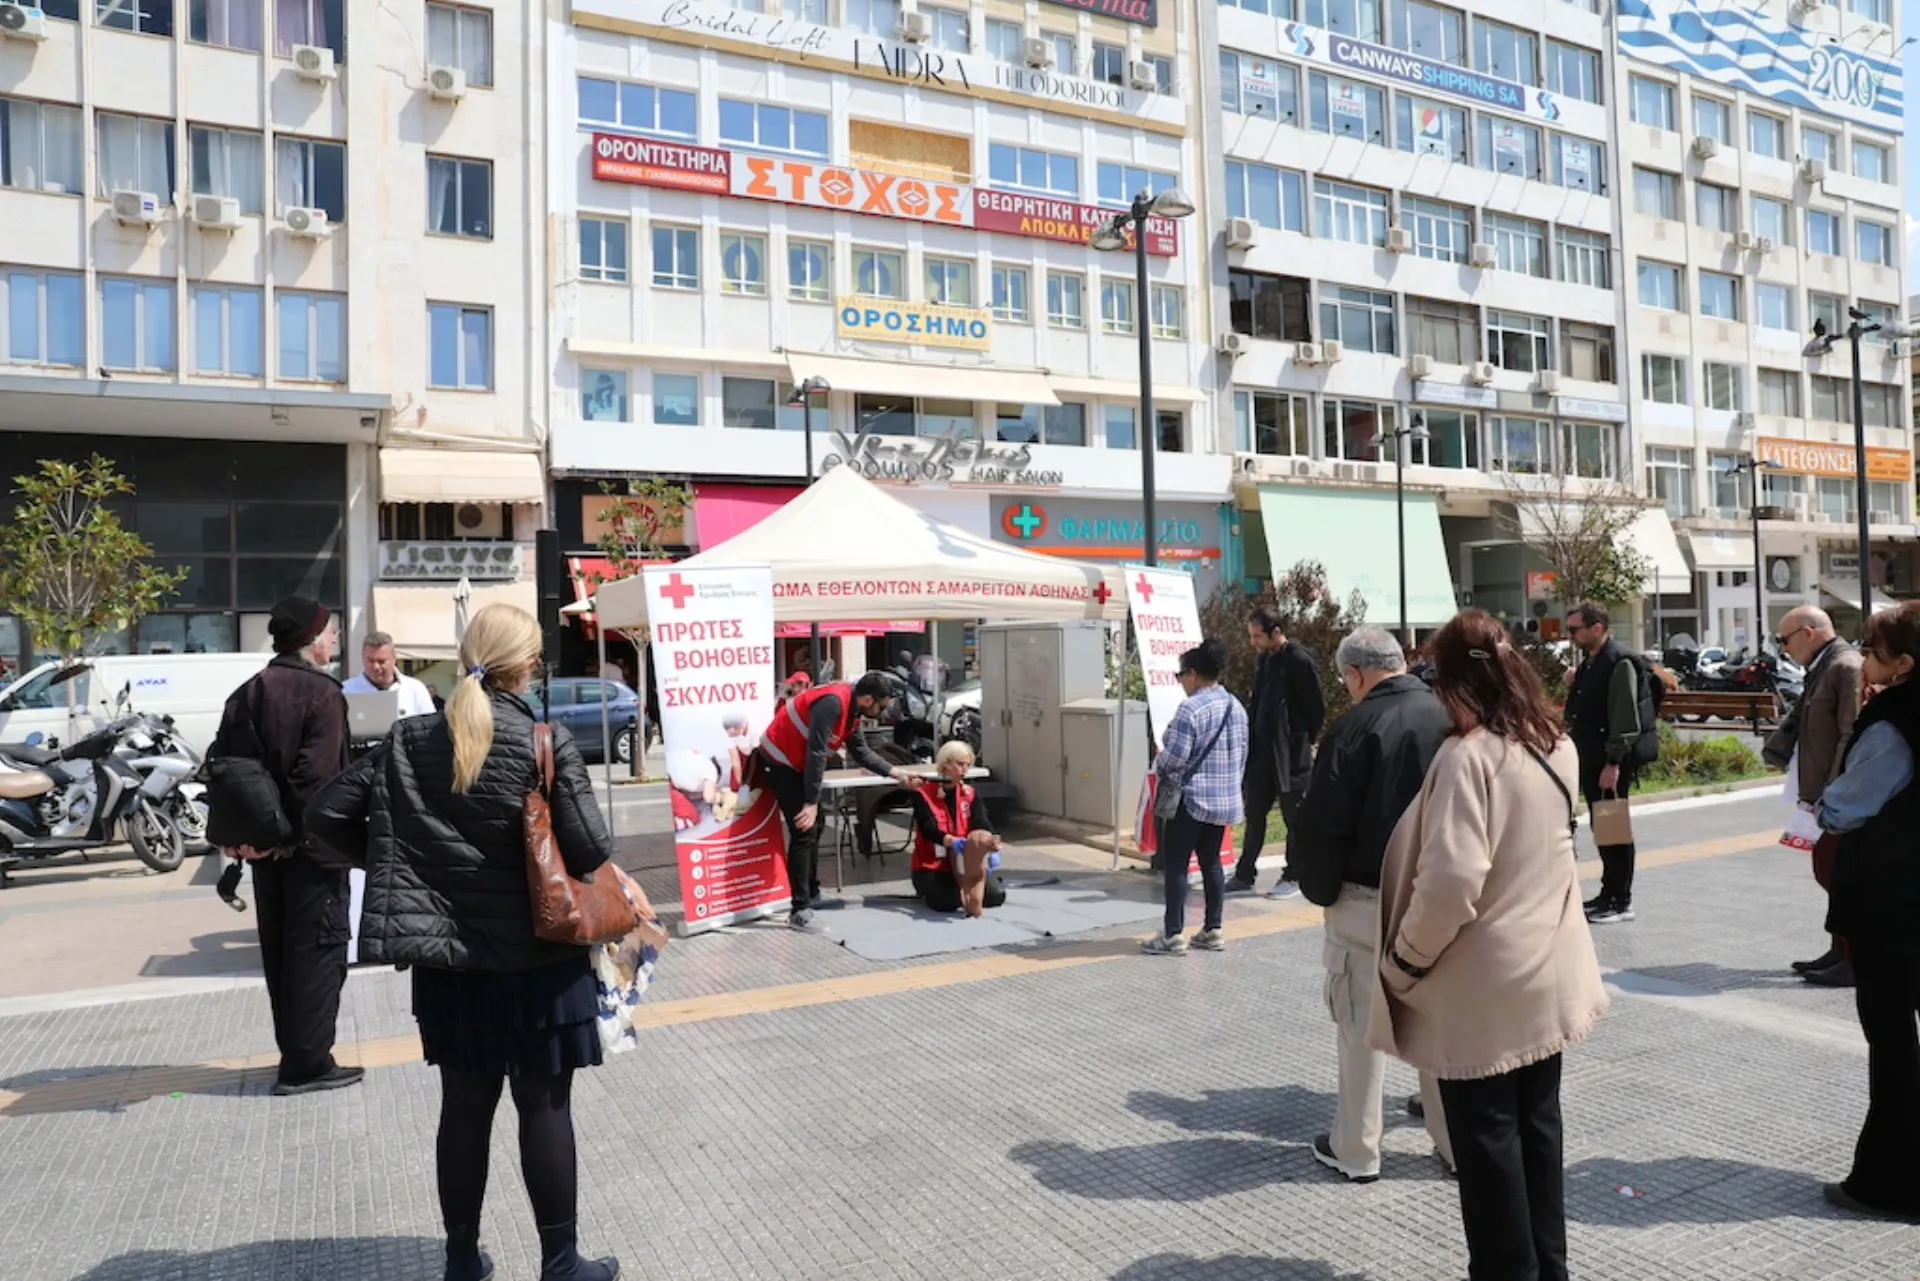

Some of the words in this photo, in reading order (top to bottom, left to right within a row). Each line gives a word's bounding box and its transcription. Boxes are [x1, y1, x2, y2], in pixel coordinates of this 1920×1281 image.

[661, 0, 760, 37] Bridal
[1810, 48, 1873, 108] 200
[1499, 87, 1519, 105] SA
[597, 137, 727, 174] ΦΡΟΝΤΙΣΤΗΡΙΑ
[746, 157, 961, 222] ΣΤΟΧΟΣ
[978, 192, 1072, 221] ΘΕΩΡΗΤΙΚΗ
[842, 307, 986, 338] ΟΡΟΣΗΜΟ
[972, 467, 1009, 482] HAIR
[1015, 469, 1063, 485] SALON
[1059, 517, 1199, 543] ΦΑΡΜΑΕΙΟ
[772, 582, 813, 597] ΩΜΑ
[818, 580, 921, 596] ΕΘΕΛΟΝΤΩΝ
[927, 581, 1026, 597] ΣΑΜΑΡΕΙΤΩΝ
[1029, 585, 1089, 600] ΑΘΗΝΑΣ
[657, 619, 743, 642] ΠΡΩΤΕΣ
[674, 646, 771, 670] ΒΟΗΘΕΙΕΣ
[665, 682, 758, 707] ΣΚΥΛΟΥΣ
